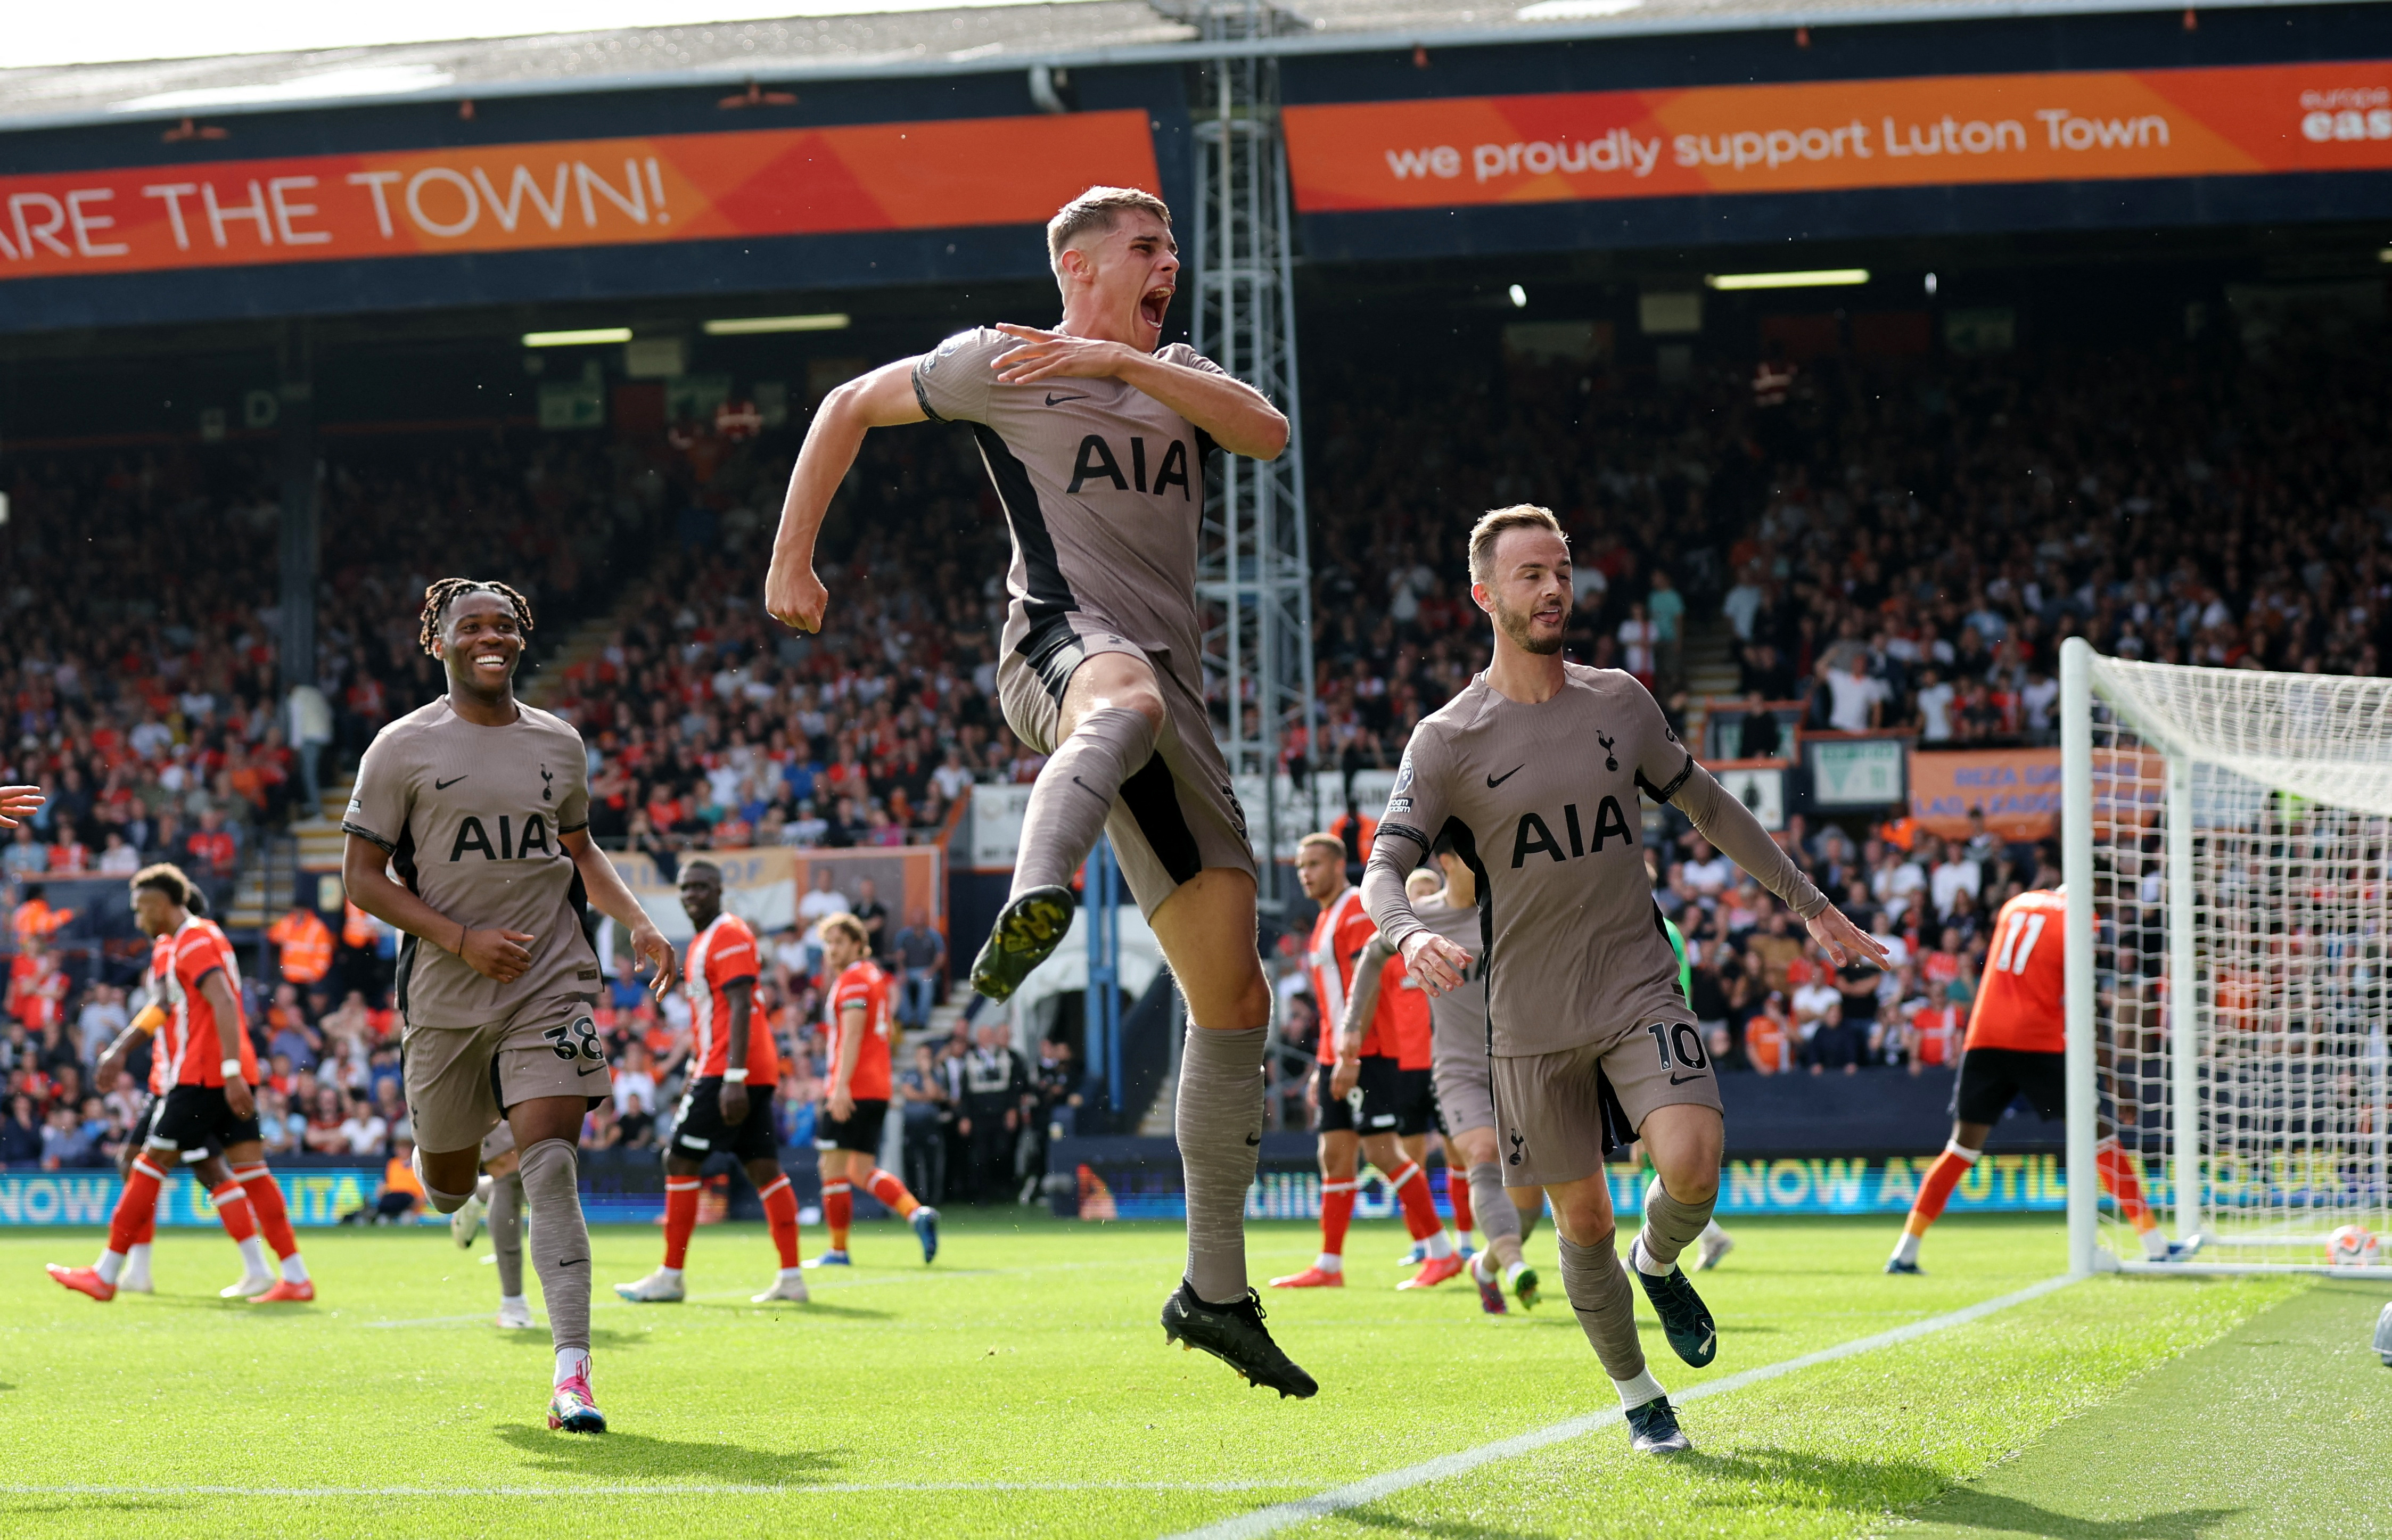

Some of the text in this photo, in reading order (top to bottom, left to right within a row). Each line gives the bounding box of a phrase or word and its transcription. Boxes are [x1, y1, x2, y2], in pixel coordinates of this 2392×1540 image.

[1386, 109, 2169, 183] we proudly support Luton Town
[142, 177, 331, 251] THE
[347, 158, 671, 238] TOWN!
[1066, 434, 1190, 502] AIA
[450, 814, 555, 862] AIA
[1511, 795, 1632, 869] AIA
[1996, 911, 2046, 975] 11
[542, 1015, 605, 1061] 38
[1647, 1022, 1707, 1072] 10
[1729, 1157, 1870, 1207] NOW
